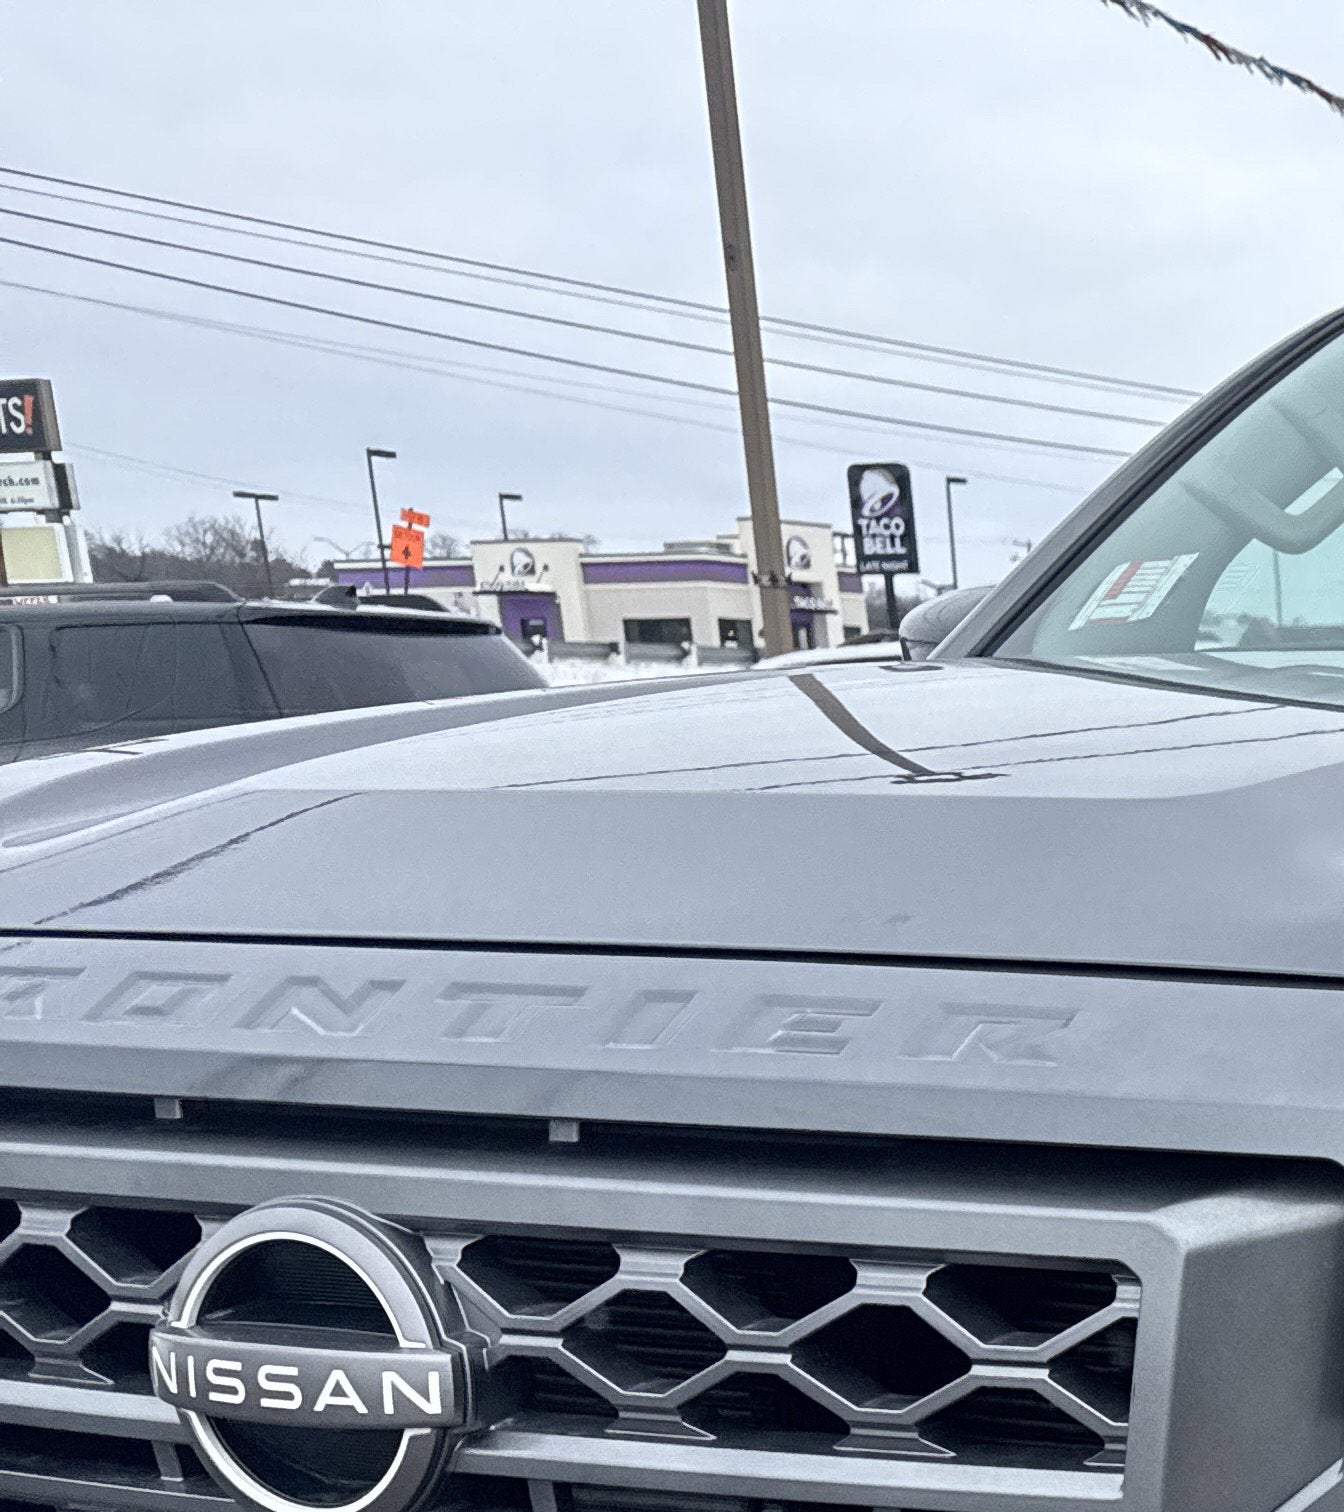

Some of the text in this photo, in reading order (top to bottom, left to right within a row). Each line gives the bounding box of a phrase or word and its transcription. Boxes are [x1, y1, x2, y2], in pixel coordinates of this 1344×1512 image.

[857, 517, 906, 537] TACO
[863, 536, 908, 555] BELL
[151, 1345, 443, 1416] NISSAN
